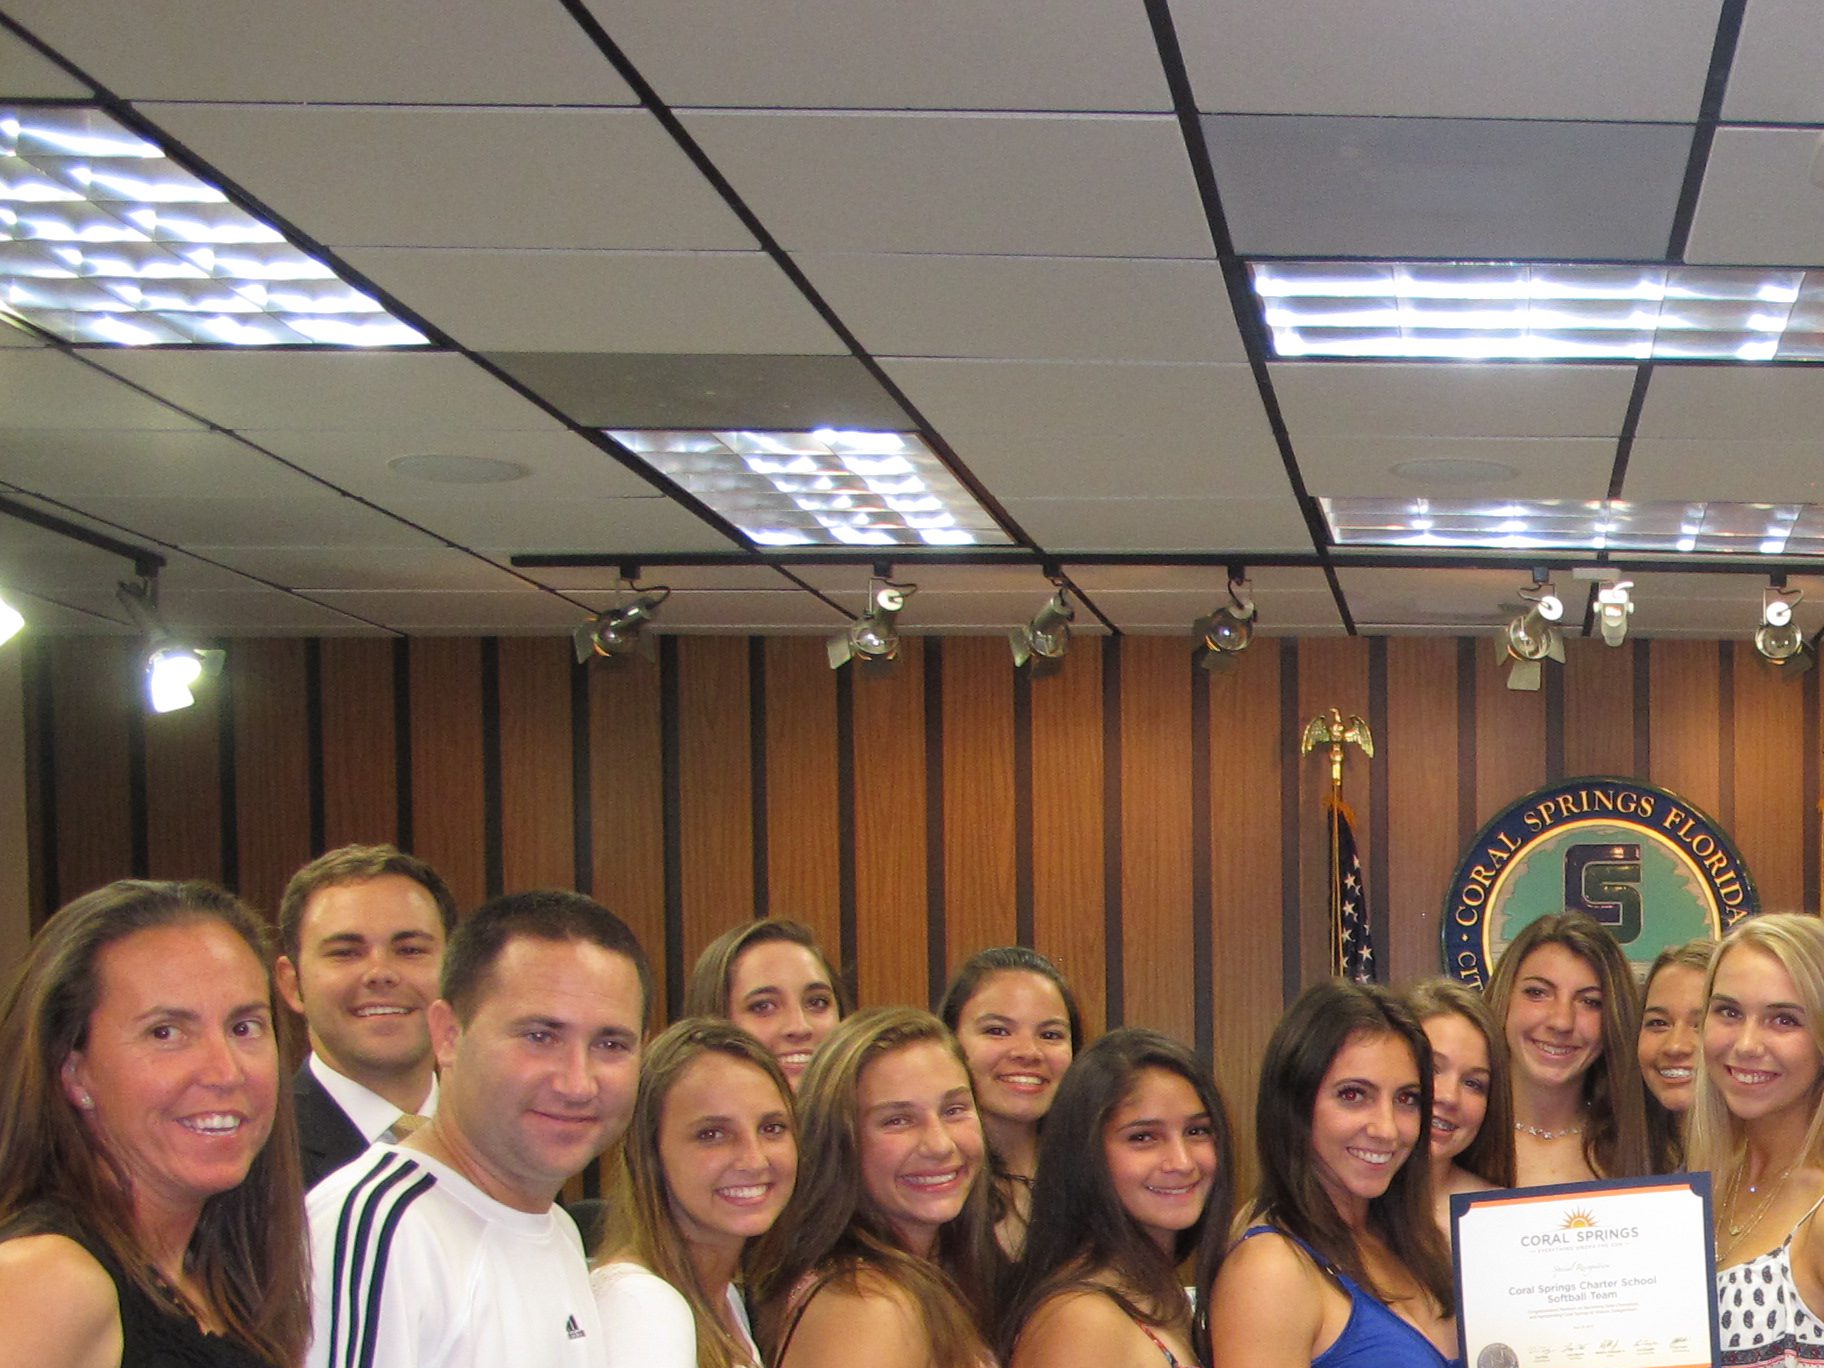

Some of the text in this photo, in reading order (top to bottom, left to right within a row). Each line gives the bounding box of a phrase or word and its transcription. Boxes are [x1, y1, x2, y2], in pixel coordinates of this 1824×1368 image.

[1455, 790, 1749, 927] CORAL SPRINGS FLORIDA
[1520, 1226, 1639, 1247] CORAL SPRINGS
[1508, 1276, 1657, 1296] Coral Springs Charter School
[1547, 1290, 1618, 1304] Softball Team
